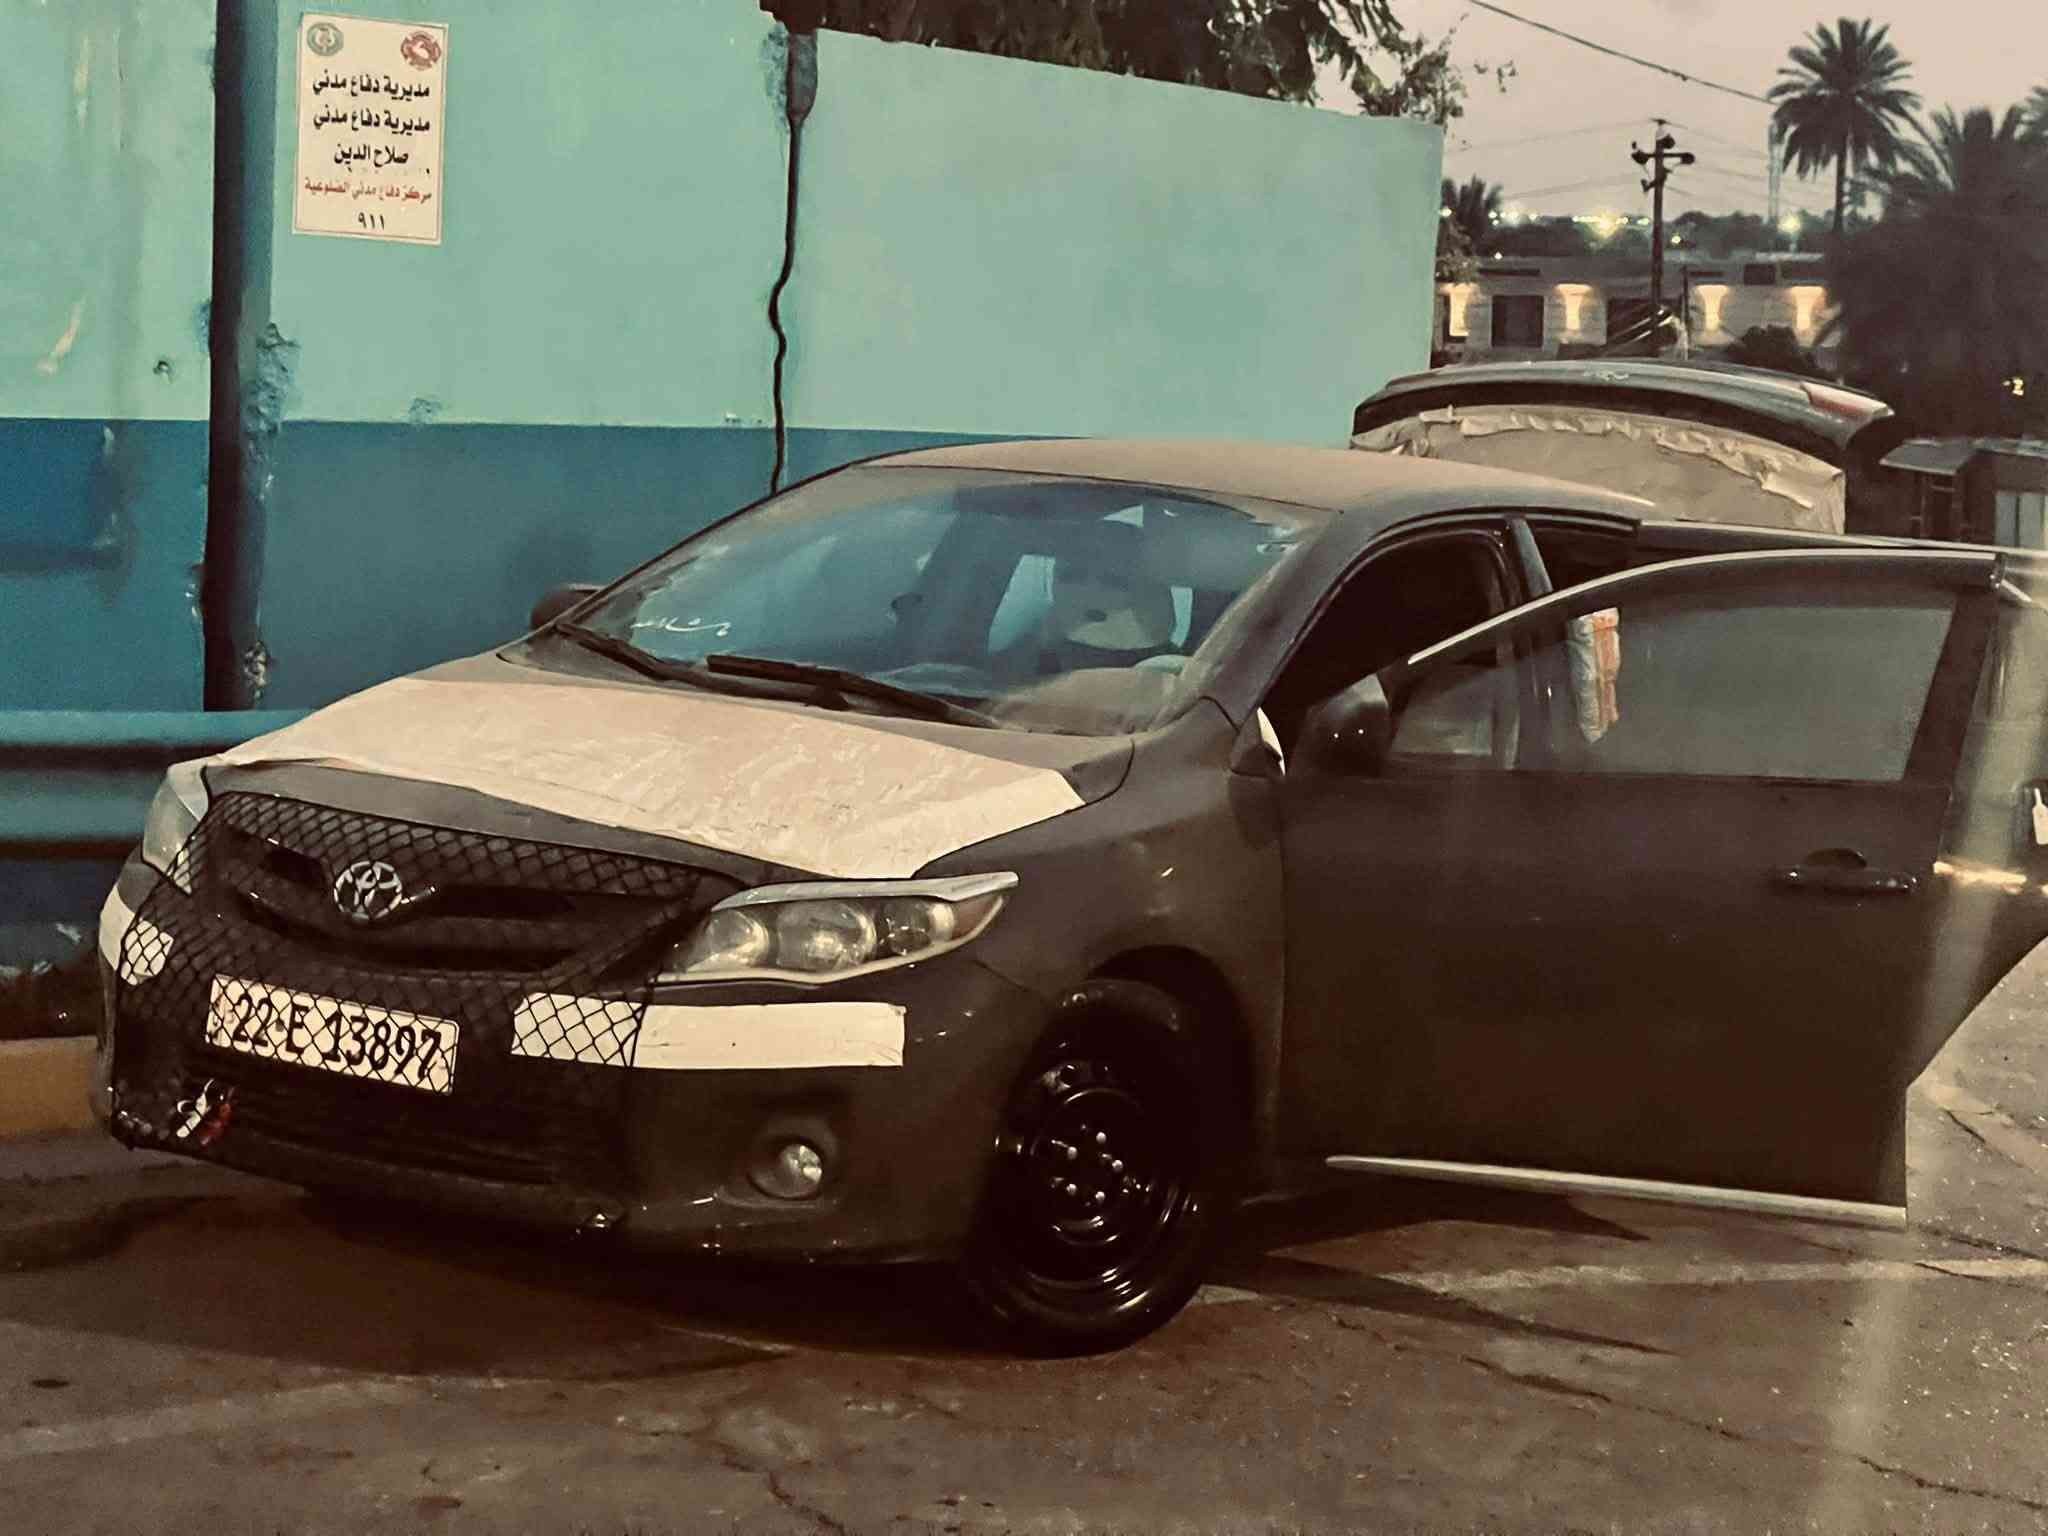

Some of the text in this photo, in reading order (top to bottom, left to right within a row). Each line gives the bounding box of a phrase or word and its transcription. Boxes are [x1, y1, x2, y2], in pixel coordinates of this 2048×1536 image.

[312, 69, 430, 102] مديرية دفاع مدني
[313, 104, 430, 136] مديرية دفاع مدني
[334, 142, 409, 167] صلاح الدين
[351, 181, 377, 201] مدني
[378, 184, 401, 202] دفاع
[402, 187, 432, 204] مركز
[357, 211, 386, 230] ٩١١
[232, 993, 273, 1047] 22
[323, 1011, 442, 1080] 13897
